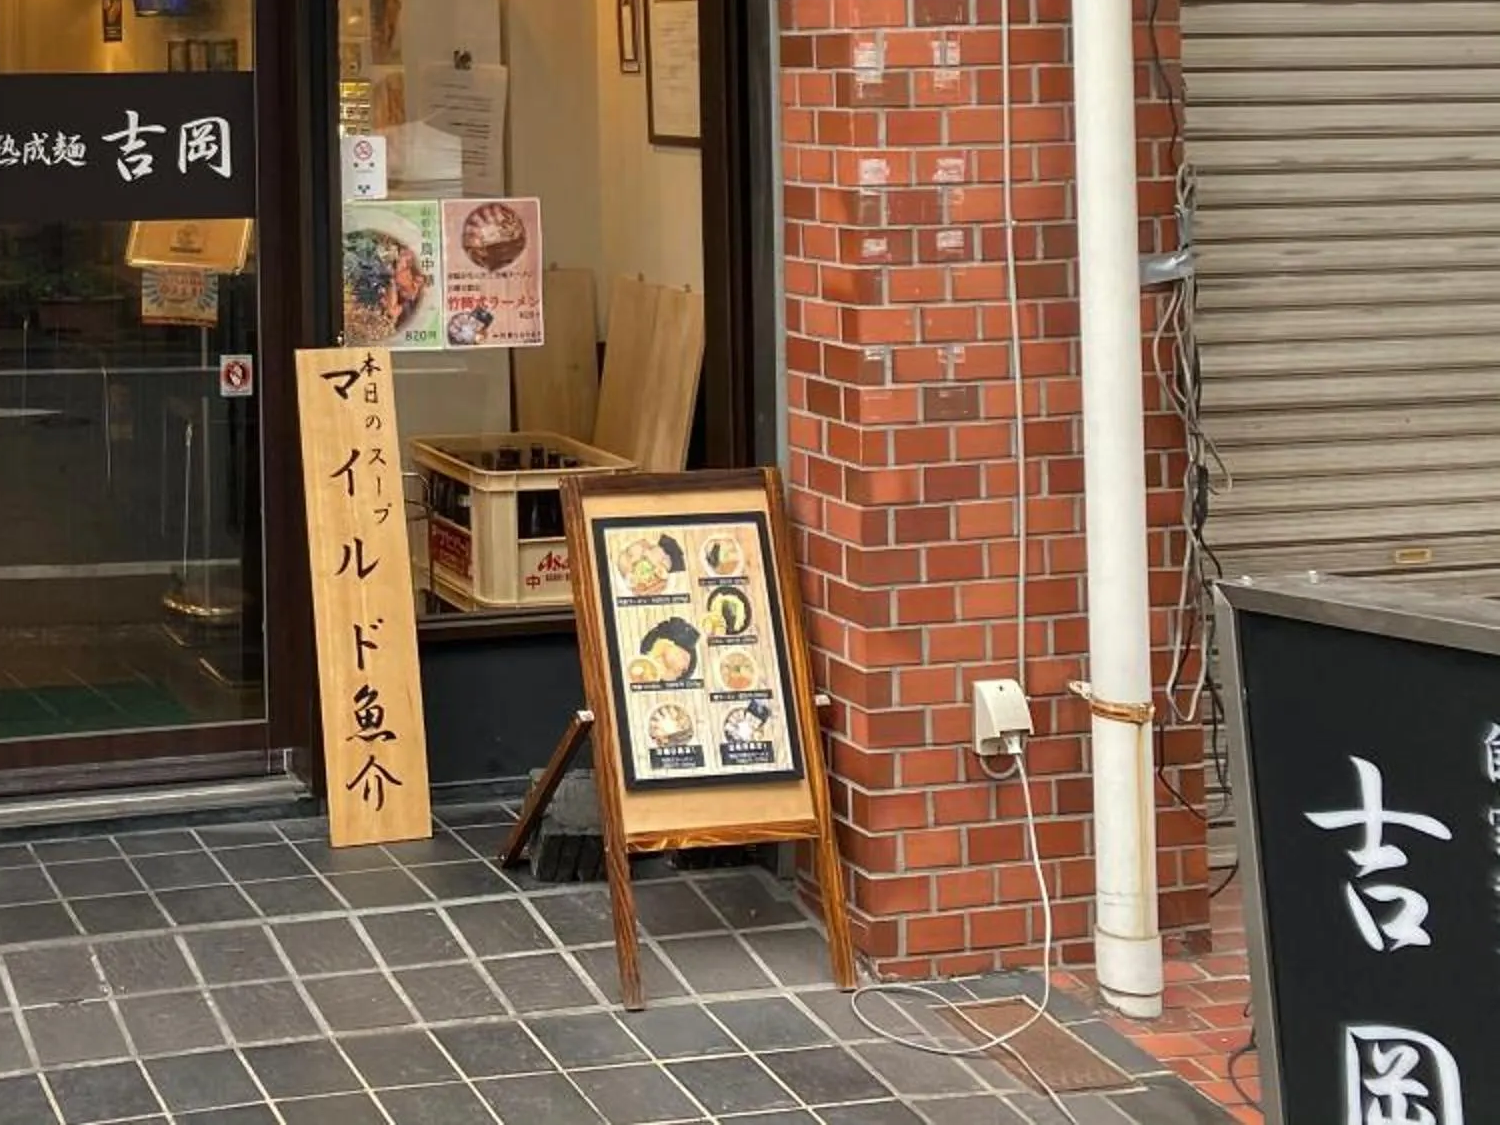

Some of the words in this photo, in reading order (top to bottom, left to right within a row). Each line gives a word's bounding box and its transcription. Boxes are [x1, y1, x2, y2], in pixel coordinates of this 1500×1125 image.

[102, 110, 232, 181] 吉岡
[359, 352, 394, 525] 本日のスープ
[319, 367, 403, 812] マイルド魚介
